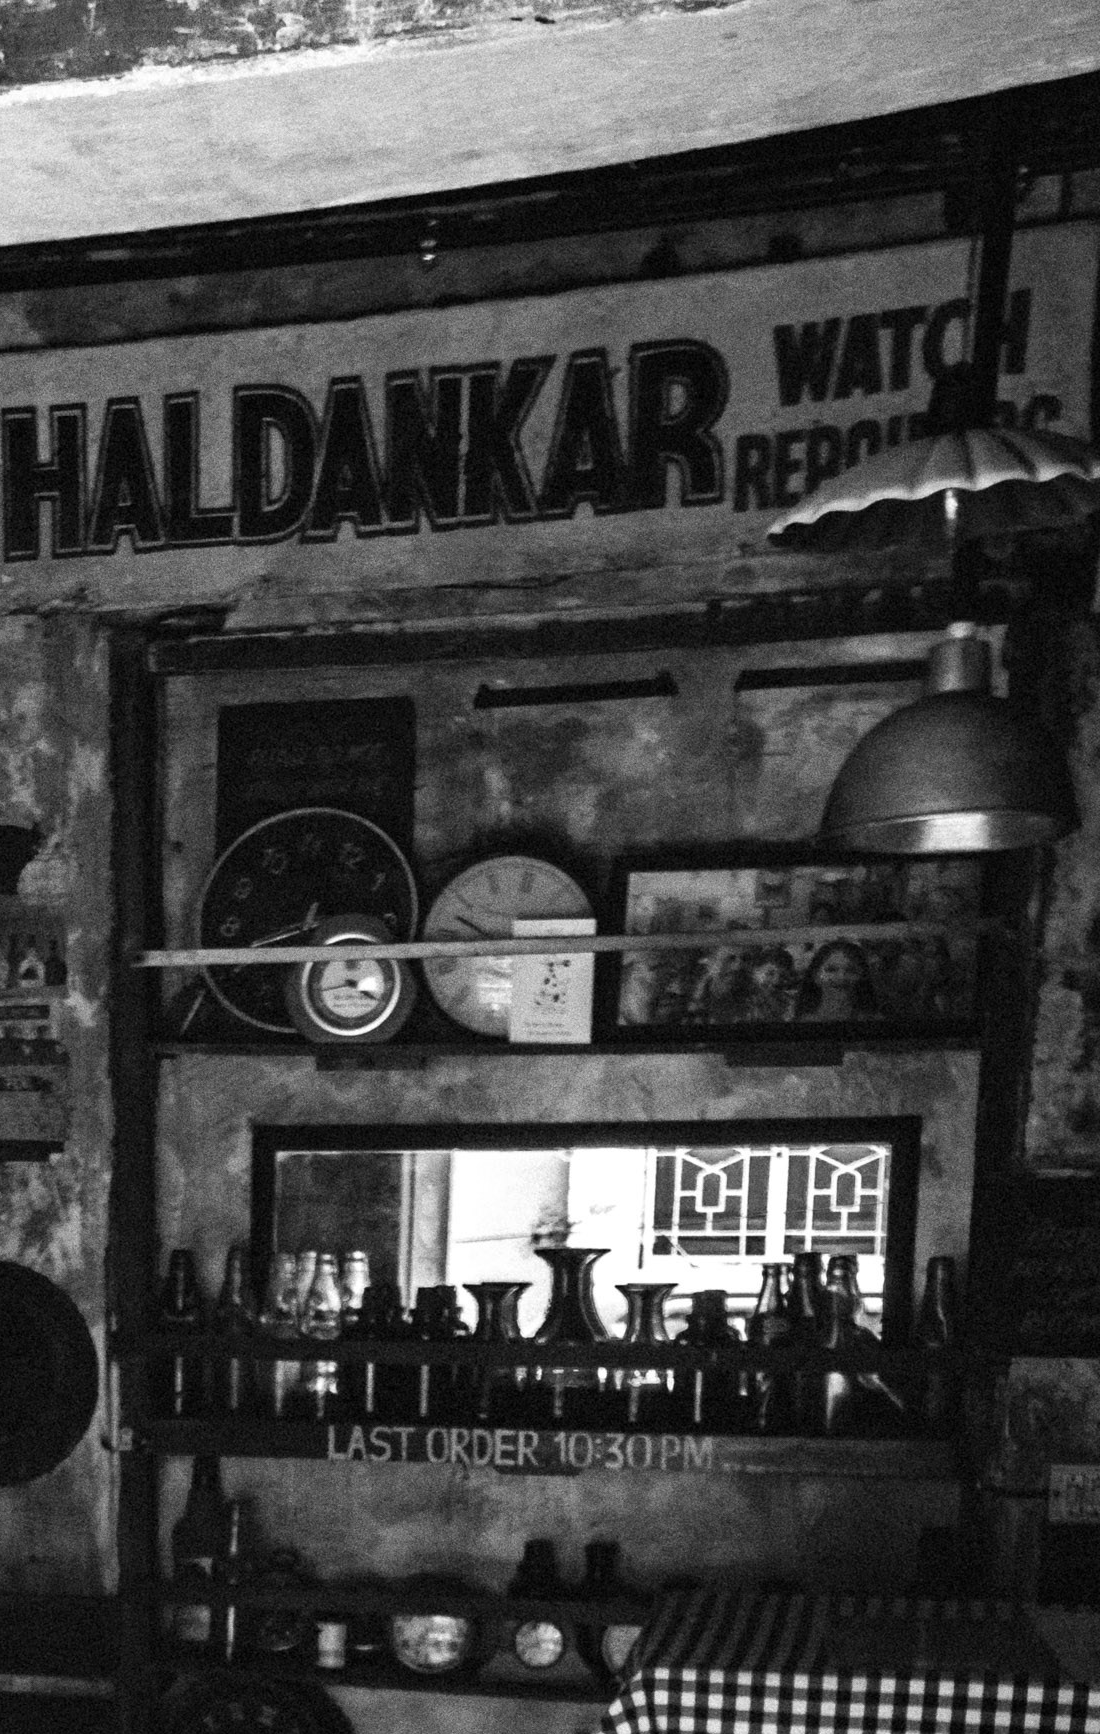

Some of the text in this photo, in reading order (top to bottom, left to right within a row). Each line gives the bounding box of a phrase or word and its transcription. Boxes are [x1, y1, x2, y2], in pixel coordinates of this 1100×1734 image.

[1, 337, 729, 562] HALDANKAR
[327, 1425, 415, 1462] LAST
[426, 1428, 539, 1467] ORDER
